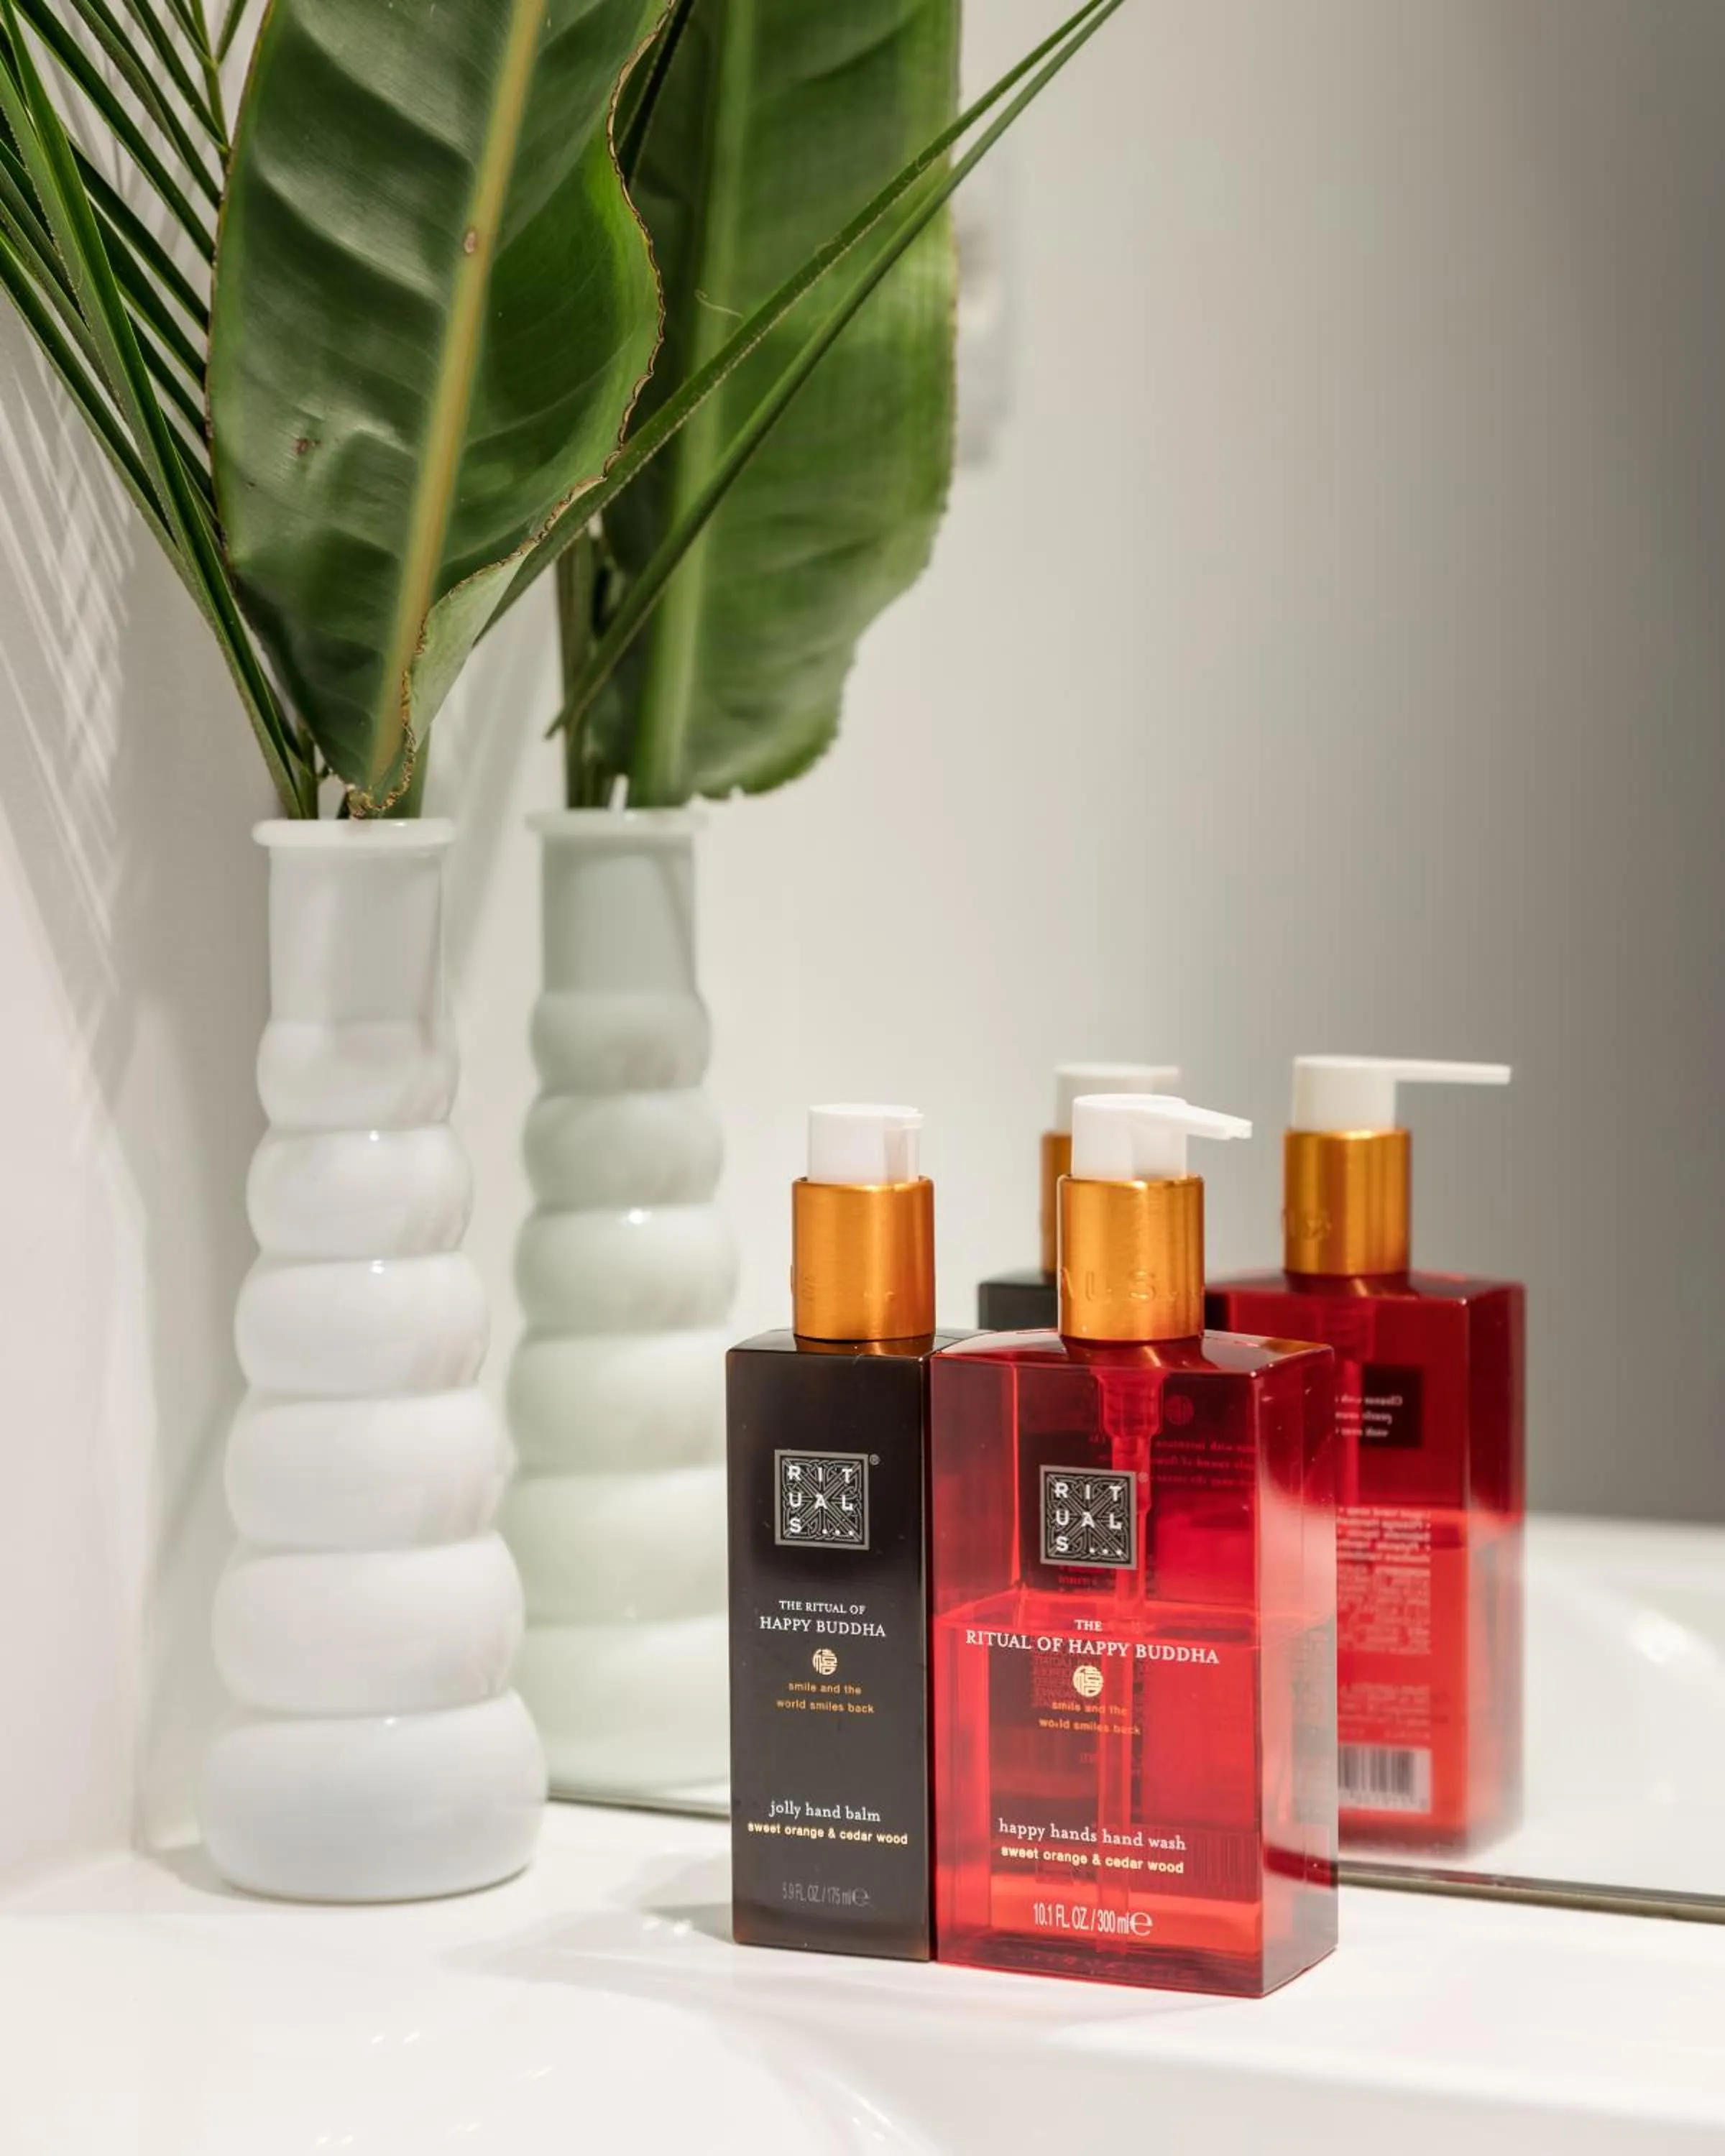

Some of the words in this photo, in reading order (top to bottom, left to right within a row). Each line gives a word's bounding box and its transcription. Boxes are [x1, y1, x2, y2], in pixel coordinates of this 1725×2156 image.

[779, 1600, 803, 1611] THE
[806, 1602, 847, 1614] RITUAL
[849, 1605, 866, 1615] OF
[759, 1616, 811, 1632] HAPPY
[816, 1619, 886, 1638] BUDDHA
[1074, 1619, 1103, 1632] THE
[966, 1629, 1031, 1651] RITUAL
[1036, 1636, 1063, 1652] OF
[1068, 1639, 1131, 1657] HAPPY
[1135, 1644, 1220, 1664] BUDDHA
[788, 1682, 816, 1692] smile
[820, 1684, 840, 1694] and
[844, 1685, 862, 1695] the
[776, 1699, 806, 1710] world
[810, 1701, 844, 1712] smiles
[847, 1703, 875, 1714] back
[1052, 1701, 1080, 1712] smile
[1084, 1705, 1105, 1714] and
[1109, 1705, 1128, 1716] the
[1073, 1721, 1110, 1733] smiles
[769, 1800, 801, 1820] jolly
[805, 1802, 842, 1820] hand
[845, 1805, 881, 1822] balm
[747, 1821, 781, 1833] sweet
[784, 1824, 824, 1840] orange
[828, 1828, 837, 1838] &
[839, 1830, 873, 1842] cedar
[876, 1833, 908, 1846] wood
[998, 1818, 1046, 1841] happy
[1050, 1823, 1098, 1843] hands
[1101, 1828, 1144, 1847] hand
[1148, 1835, 1186, 1851] wash
[1000, 1846, 1039, 1860] sweet
[1043, 1850, 1088, 1866] orange
[1092, 1853, 1101, 1866] &
[1105, 1855, 1144, 1870] cedar
[1147, 1858, 1184, 1874] wood
[1034, 1902, 1053, 1927] 10.1
[1098, 1909, 1116, 1932] 300
